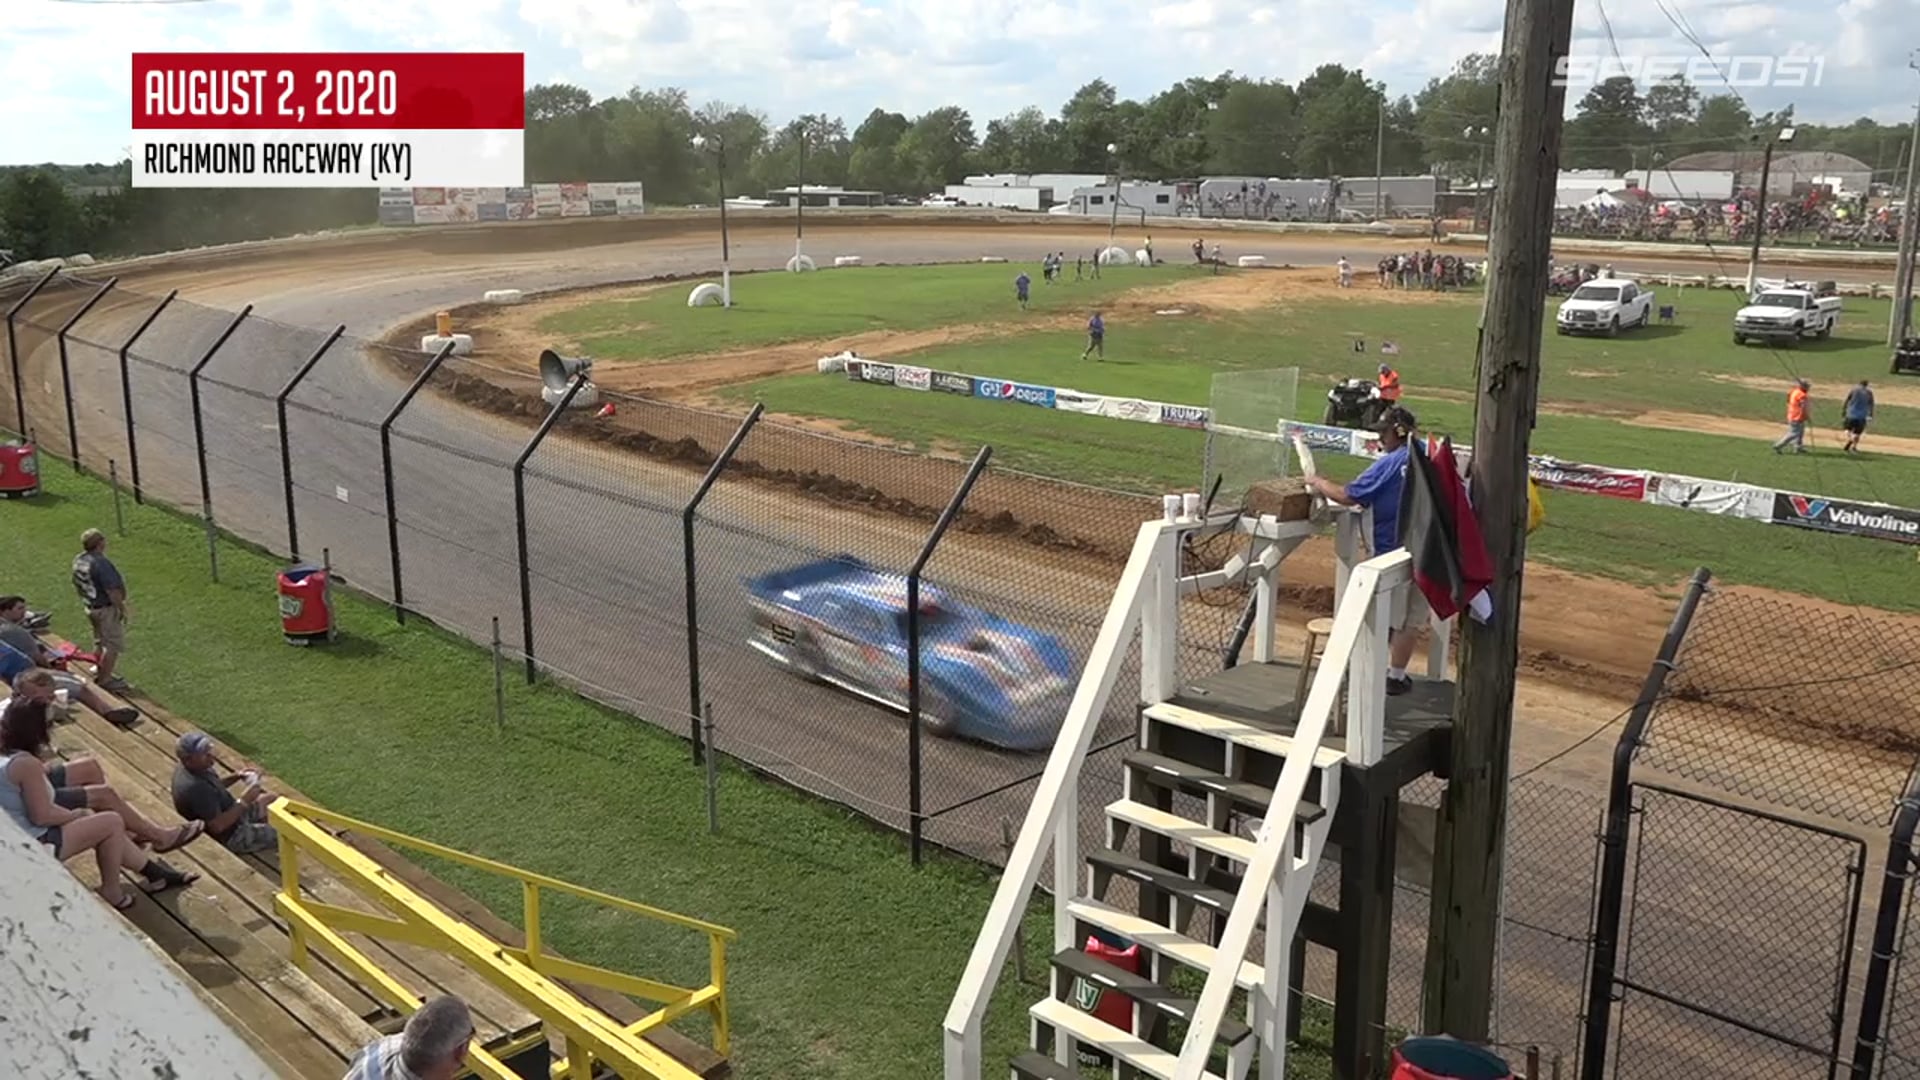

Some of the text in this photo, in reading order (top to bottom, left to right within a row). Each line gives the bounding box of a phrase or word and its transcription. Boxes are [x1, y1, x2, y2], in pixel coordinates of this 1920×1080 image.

[1016, 388, 1047, 402] pepsi
[1163, 406, 1203, 421] TRUMP
[1828, 506, 1919, 533] Valvoline
